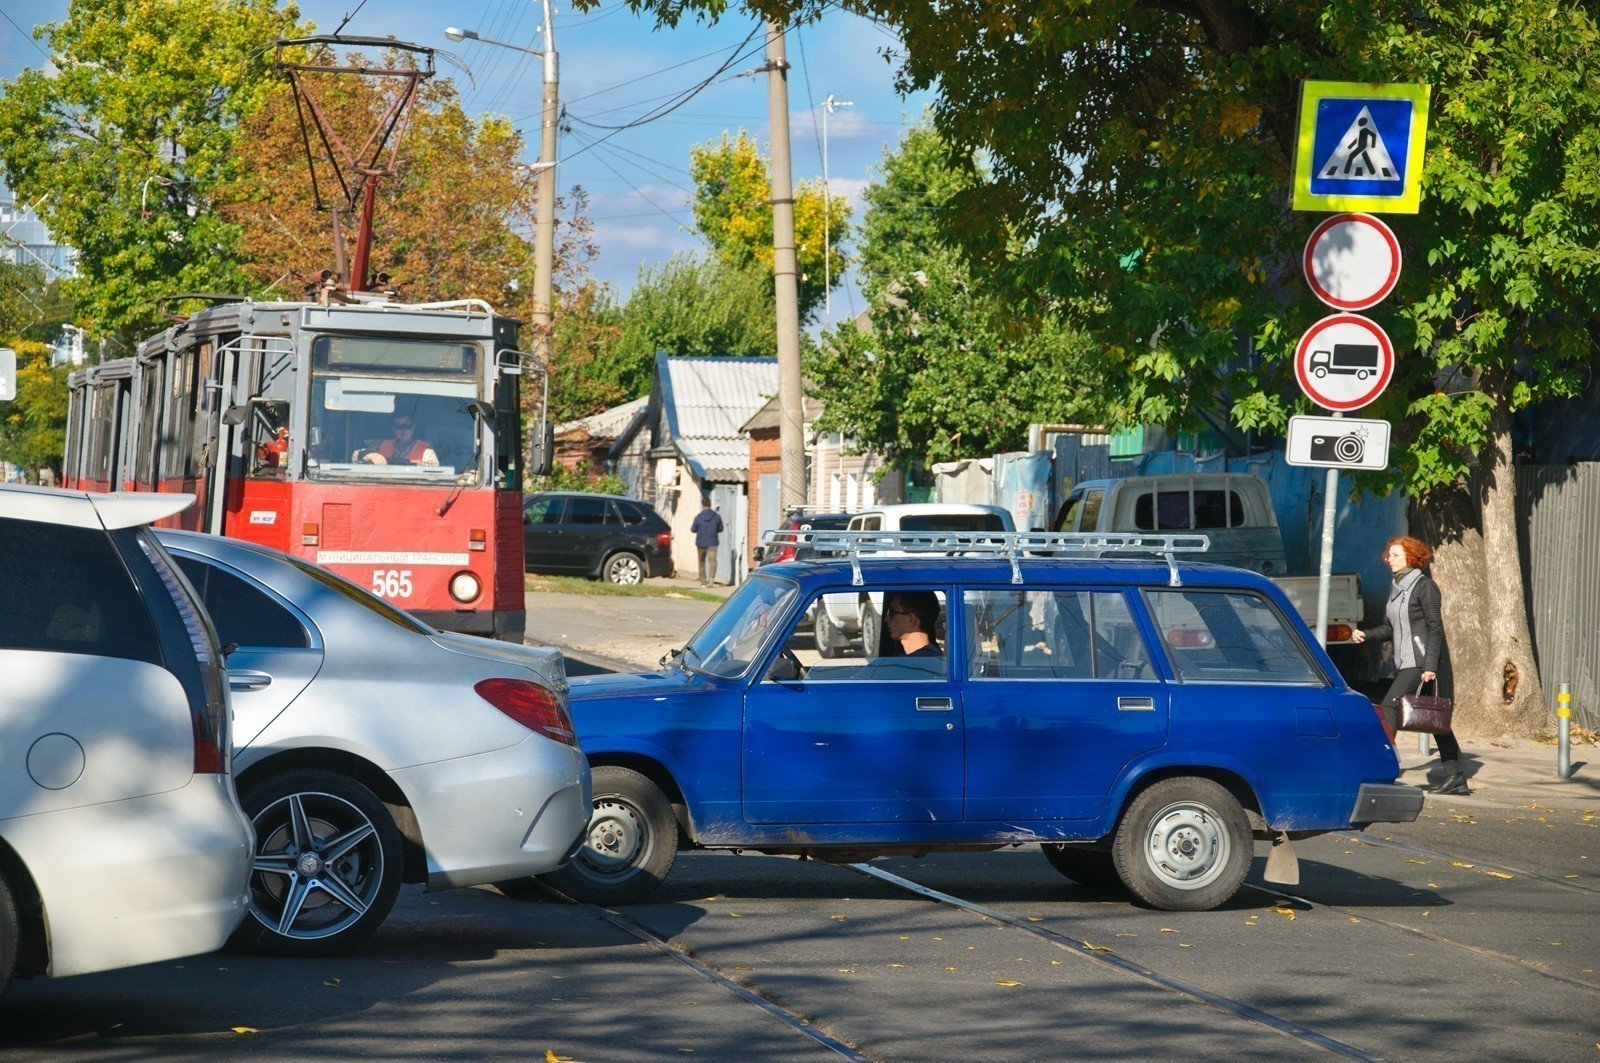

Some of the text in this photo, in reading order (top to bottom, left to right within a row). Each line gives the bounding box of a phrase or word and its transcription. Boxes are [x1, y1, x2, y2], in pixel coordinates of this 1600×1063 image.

[319, 552, 468, 564] МУНИЦИПАЛЬНЫЙ ТРАНСПОРТ
[372, 569, 413, 598] 565
